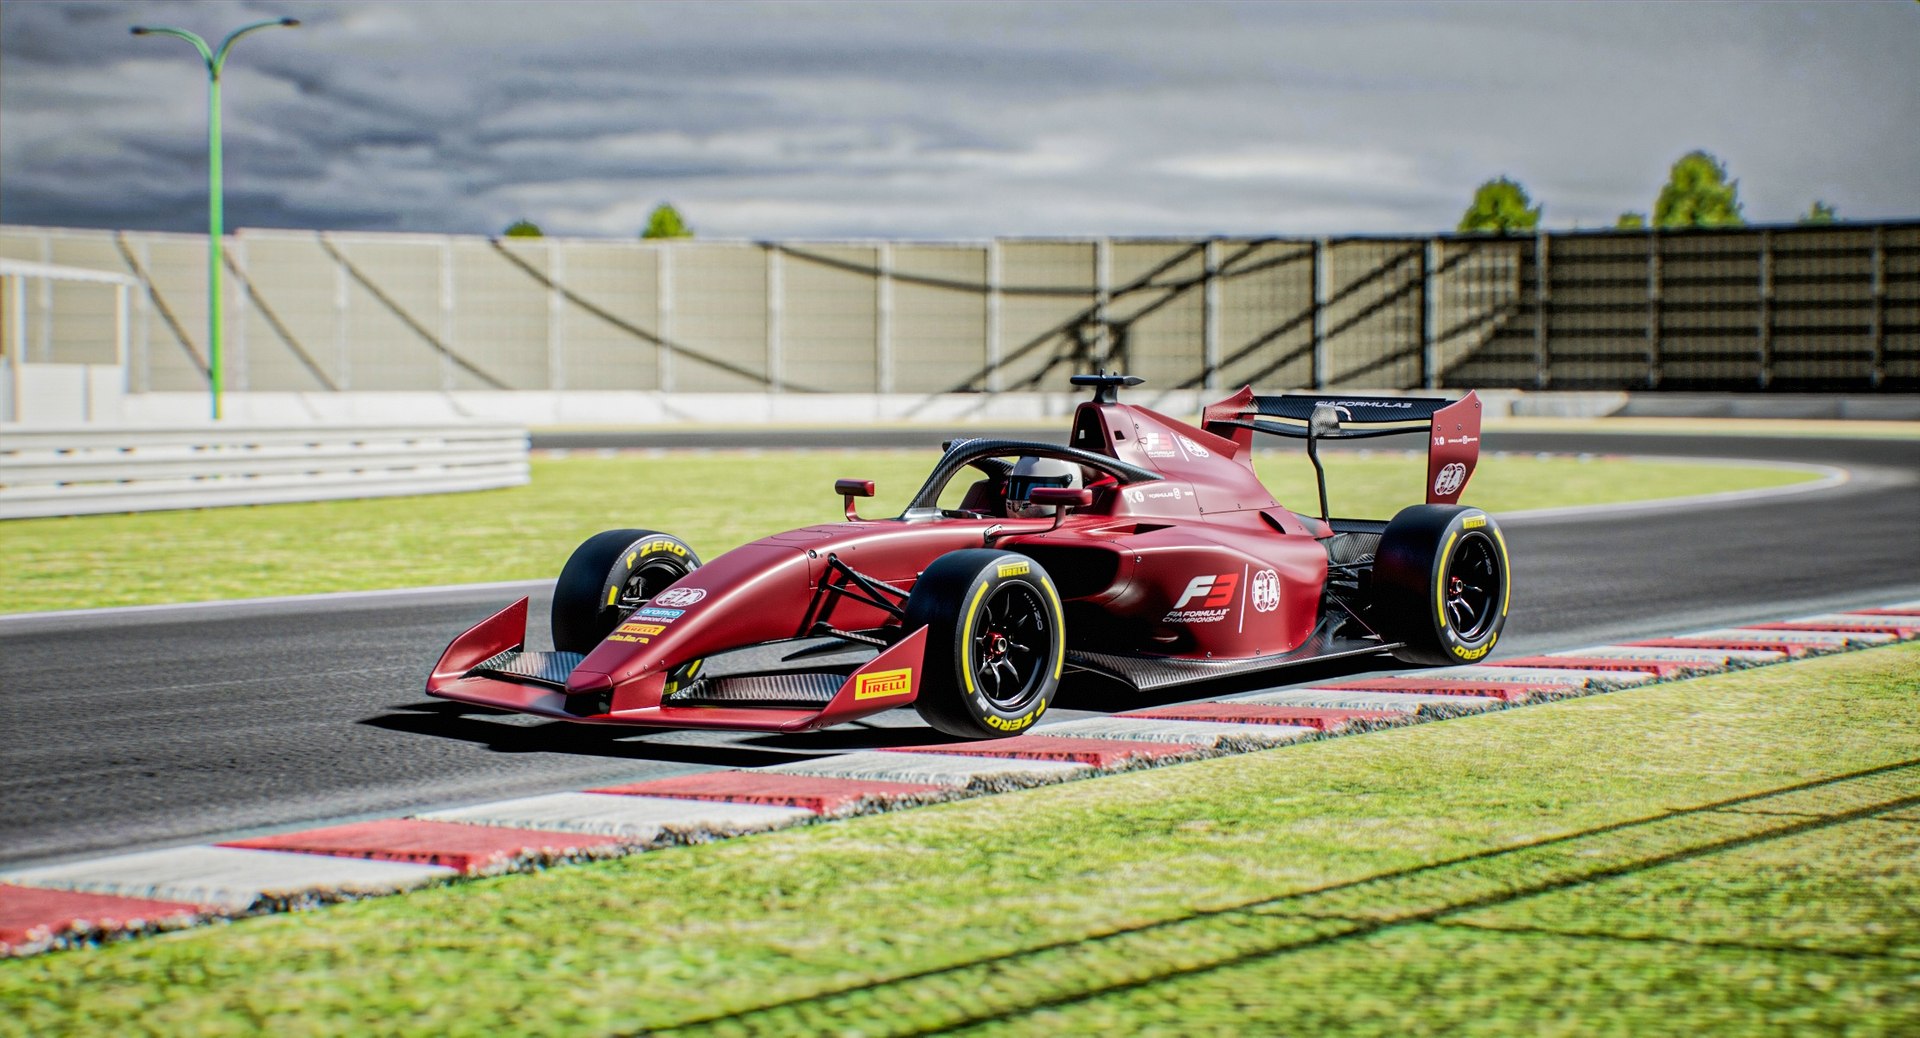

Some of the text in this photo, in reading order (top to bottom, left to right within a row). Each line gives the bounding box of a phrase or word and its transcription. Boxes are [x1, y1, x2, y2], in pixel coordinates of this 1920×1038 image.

[626, 540, 687, 570] P ZERO
[997, 561, 1030, 578] PIRELLI
[1173, 573, 1239, 609] F3
[1253, 575, 1279, 606] FIA
[641, 608, 680, 616] aramco
[1162, 615, 1225, 623] CHAMPIONSHIP
[1454, 643, 1489, 660] ZERO
[861, 674, 906, 694] PIRELLI
[987, 697, 1047, 731] P ZERO
